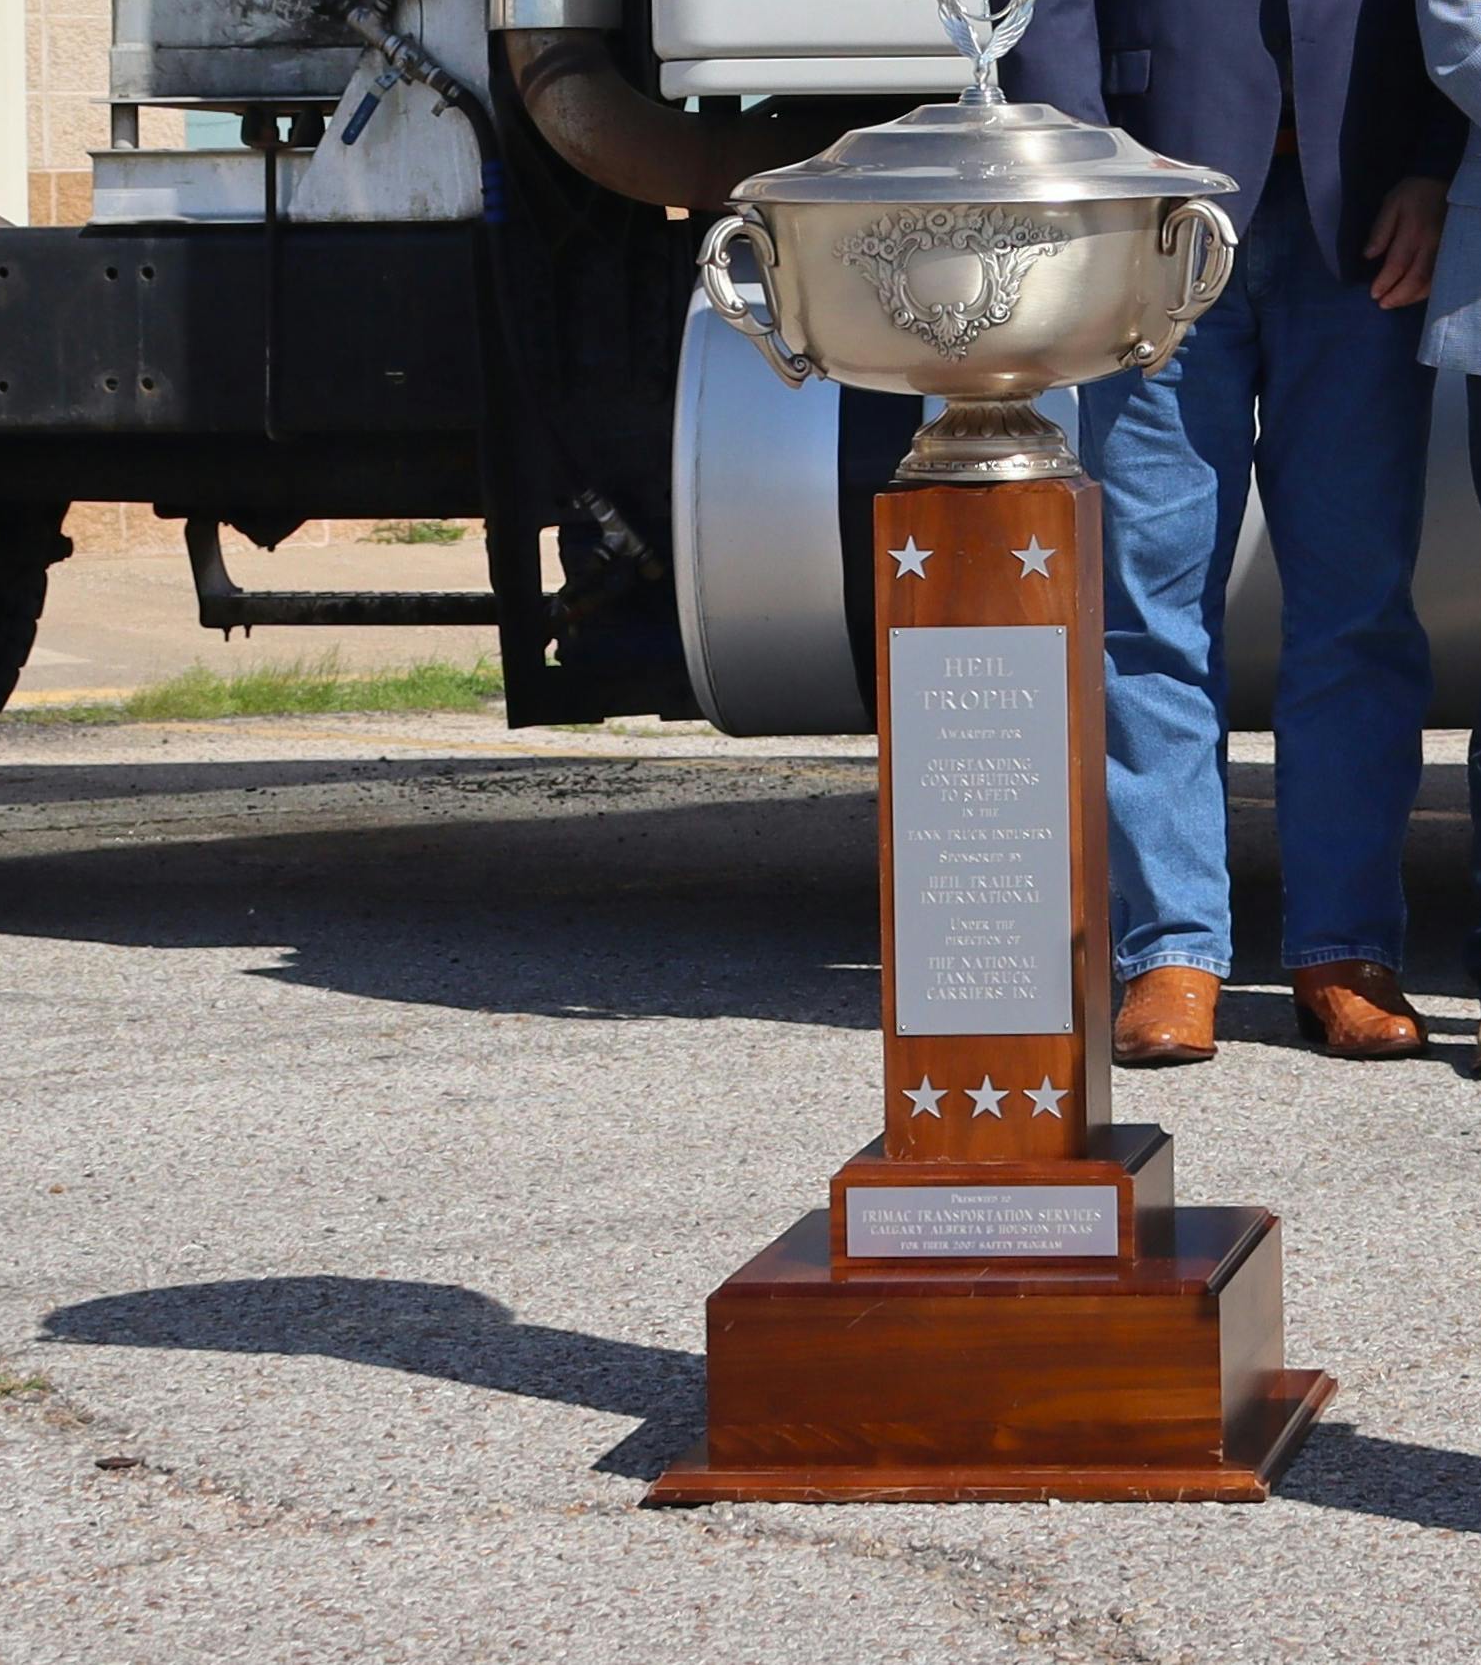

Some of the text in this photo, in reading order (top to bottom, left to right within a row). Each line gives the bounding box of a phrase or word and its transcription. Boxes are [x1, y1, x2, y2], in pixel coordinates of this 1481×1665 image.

[943, 657, 1014, 678] HEIL
[919, 688, 1039, 711] TROPHY
[927, 758, 1031, 772] OUTSTANDING
[920, 773, 1040, 788] CONTRIBUTIONS
[940, 789, 1021, 803] TO SAFETY
[907, 829, 1055, 841] TANK TRUCK INDUSTRY
[929, 875, 1035, 888] HEIL TRAILER
[920, 890, 1043, 904] INTERNATIONAL
[927, 956, 1039, 970] THE NATIONAL
[936, 971, 1032, 985] TANK TRUCK
[862, 1209, 1102, 1223] TRIMAC TRANSPORTATION SERVICES
[932, 1224, 982, 1235] ALBERTA
[1056, 1224, 1094, 1235] TEXAS
[900, 1240, 919, 1250] FOR
[978, 1240, 1013, 1250] SAFETY
[1017, 1240, 1063, 1250] PROGRAM
